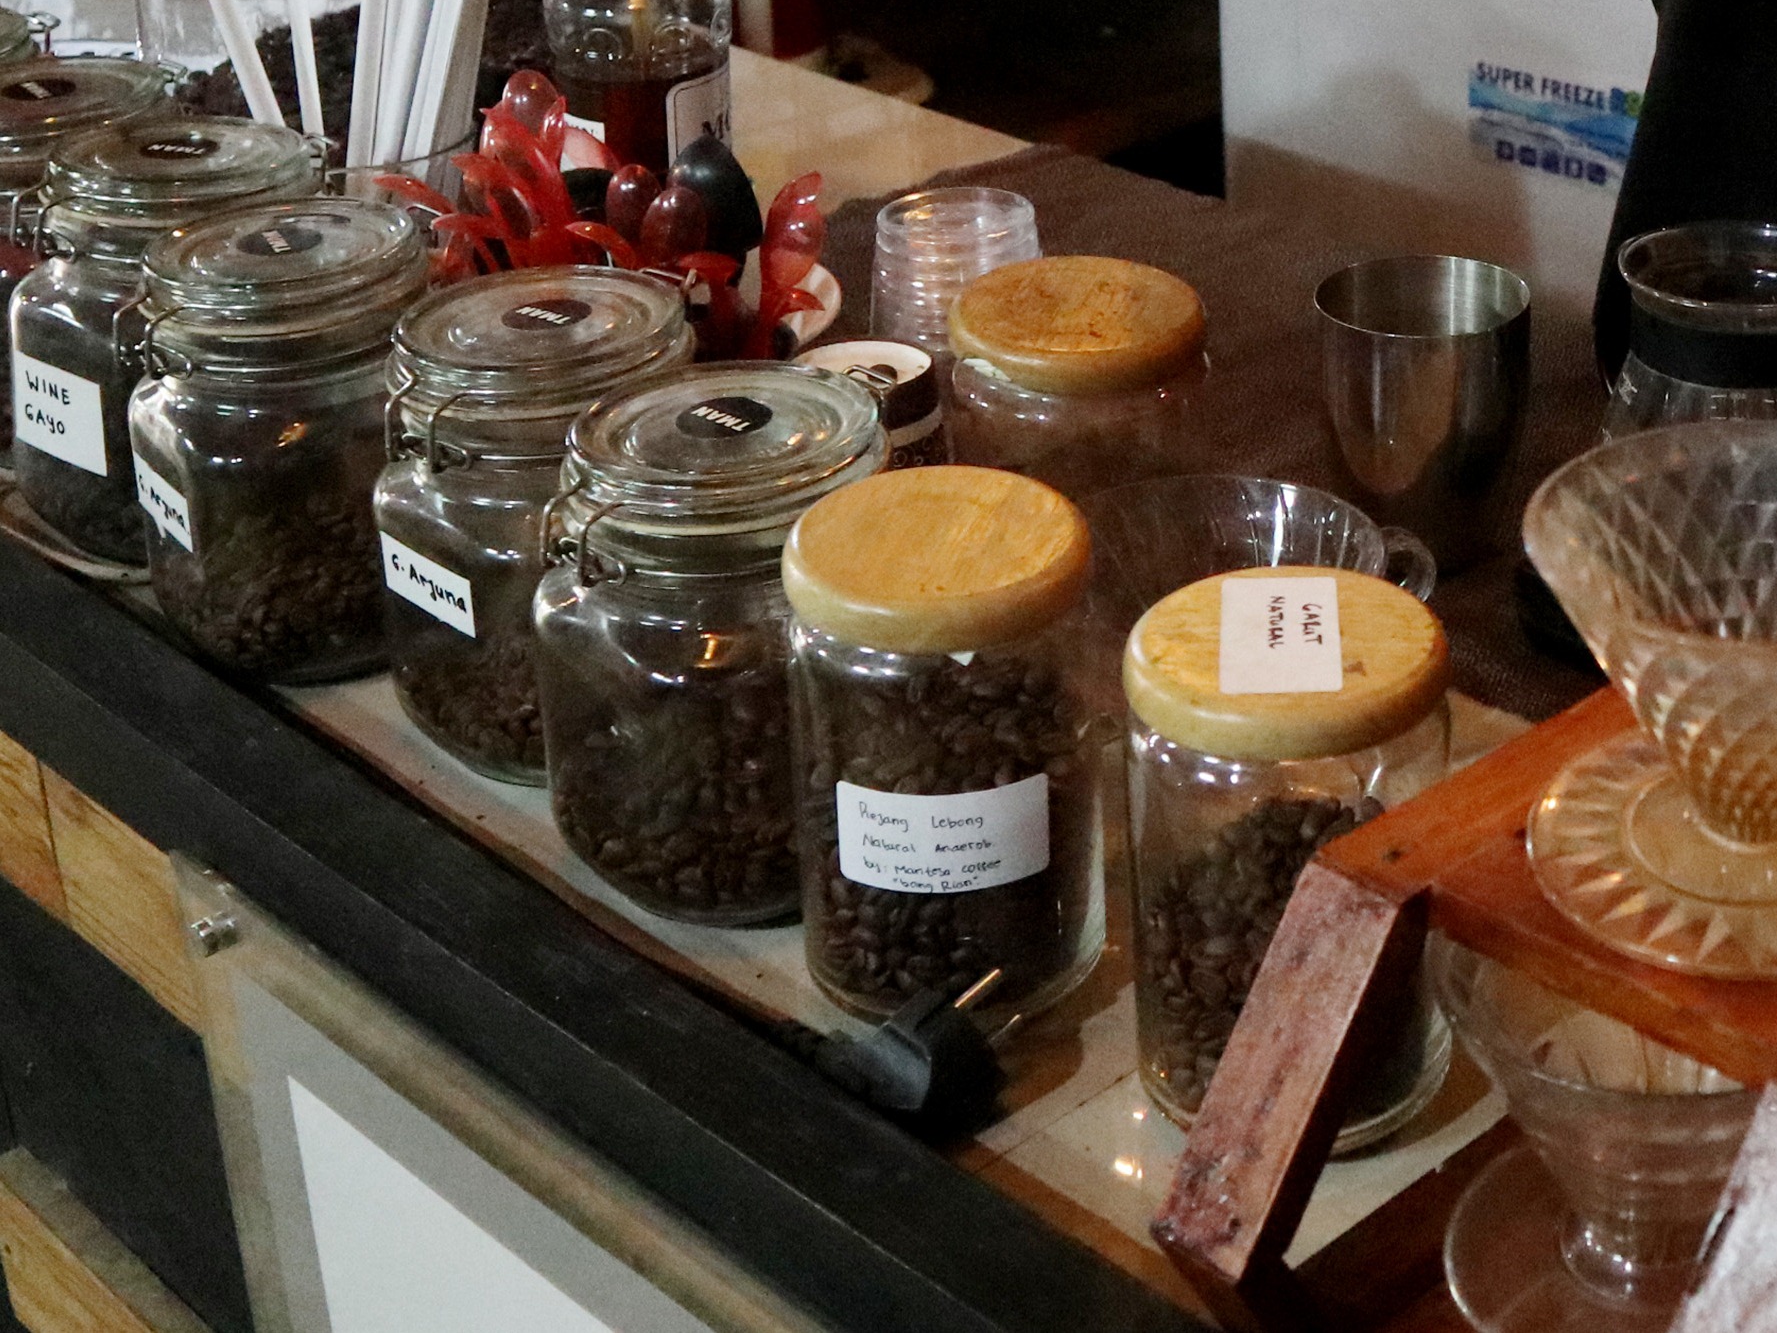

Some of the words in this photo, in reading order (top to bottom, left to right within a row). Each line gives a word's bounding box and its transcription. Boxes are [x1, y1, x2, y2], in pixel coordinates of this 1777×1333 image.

[1476, 62, 1534, 94] SUPER
[1540, 77, 1606, 110] FREEZE
[25, 370, 72, 406] WINE
[690, 406, 751, 432] TMAN
[1267, 595, 1286, 650] NATURAL
[859, 801, 909, 833] Rejang
[862, 833, 916, 853] Natural
